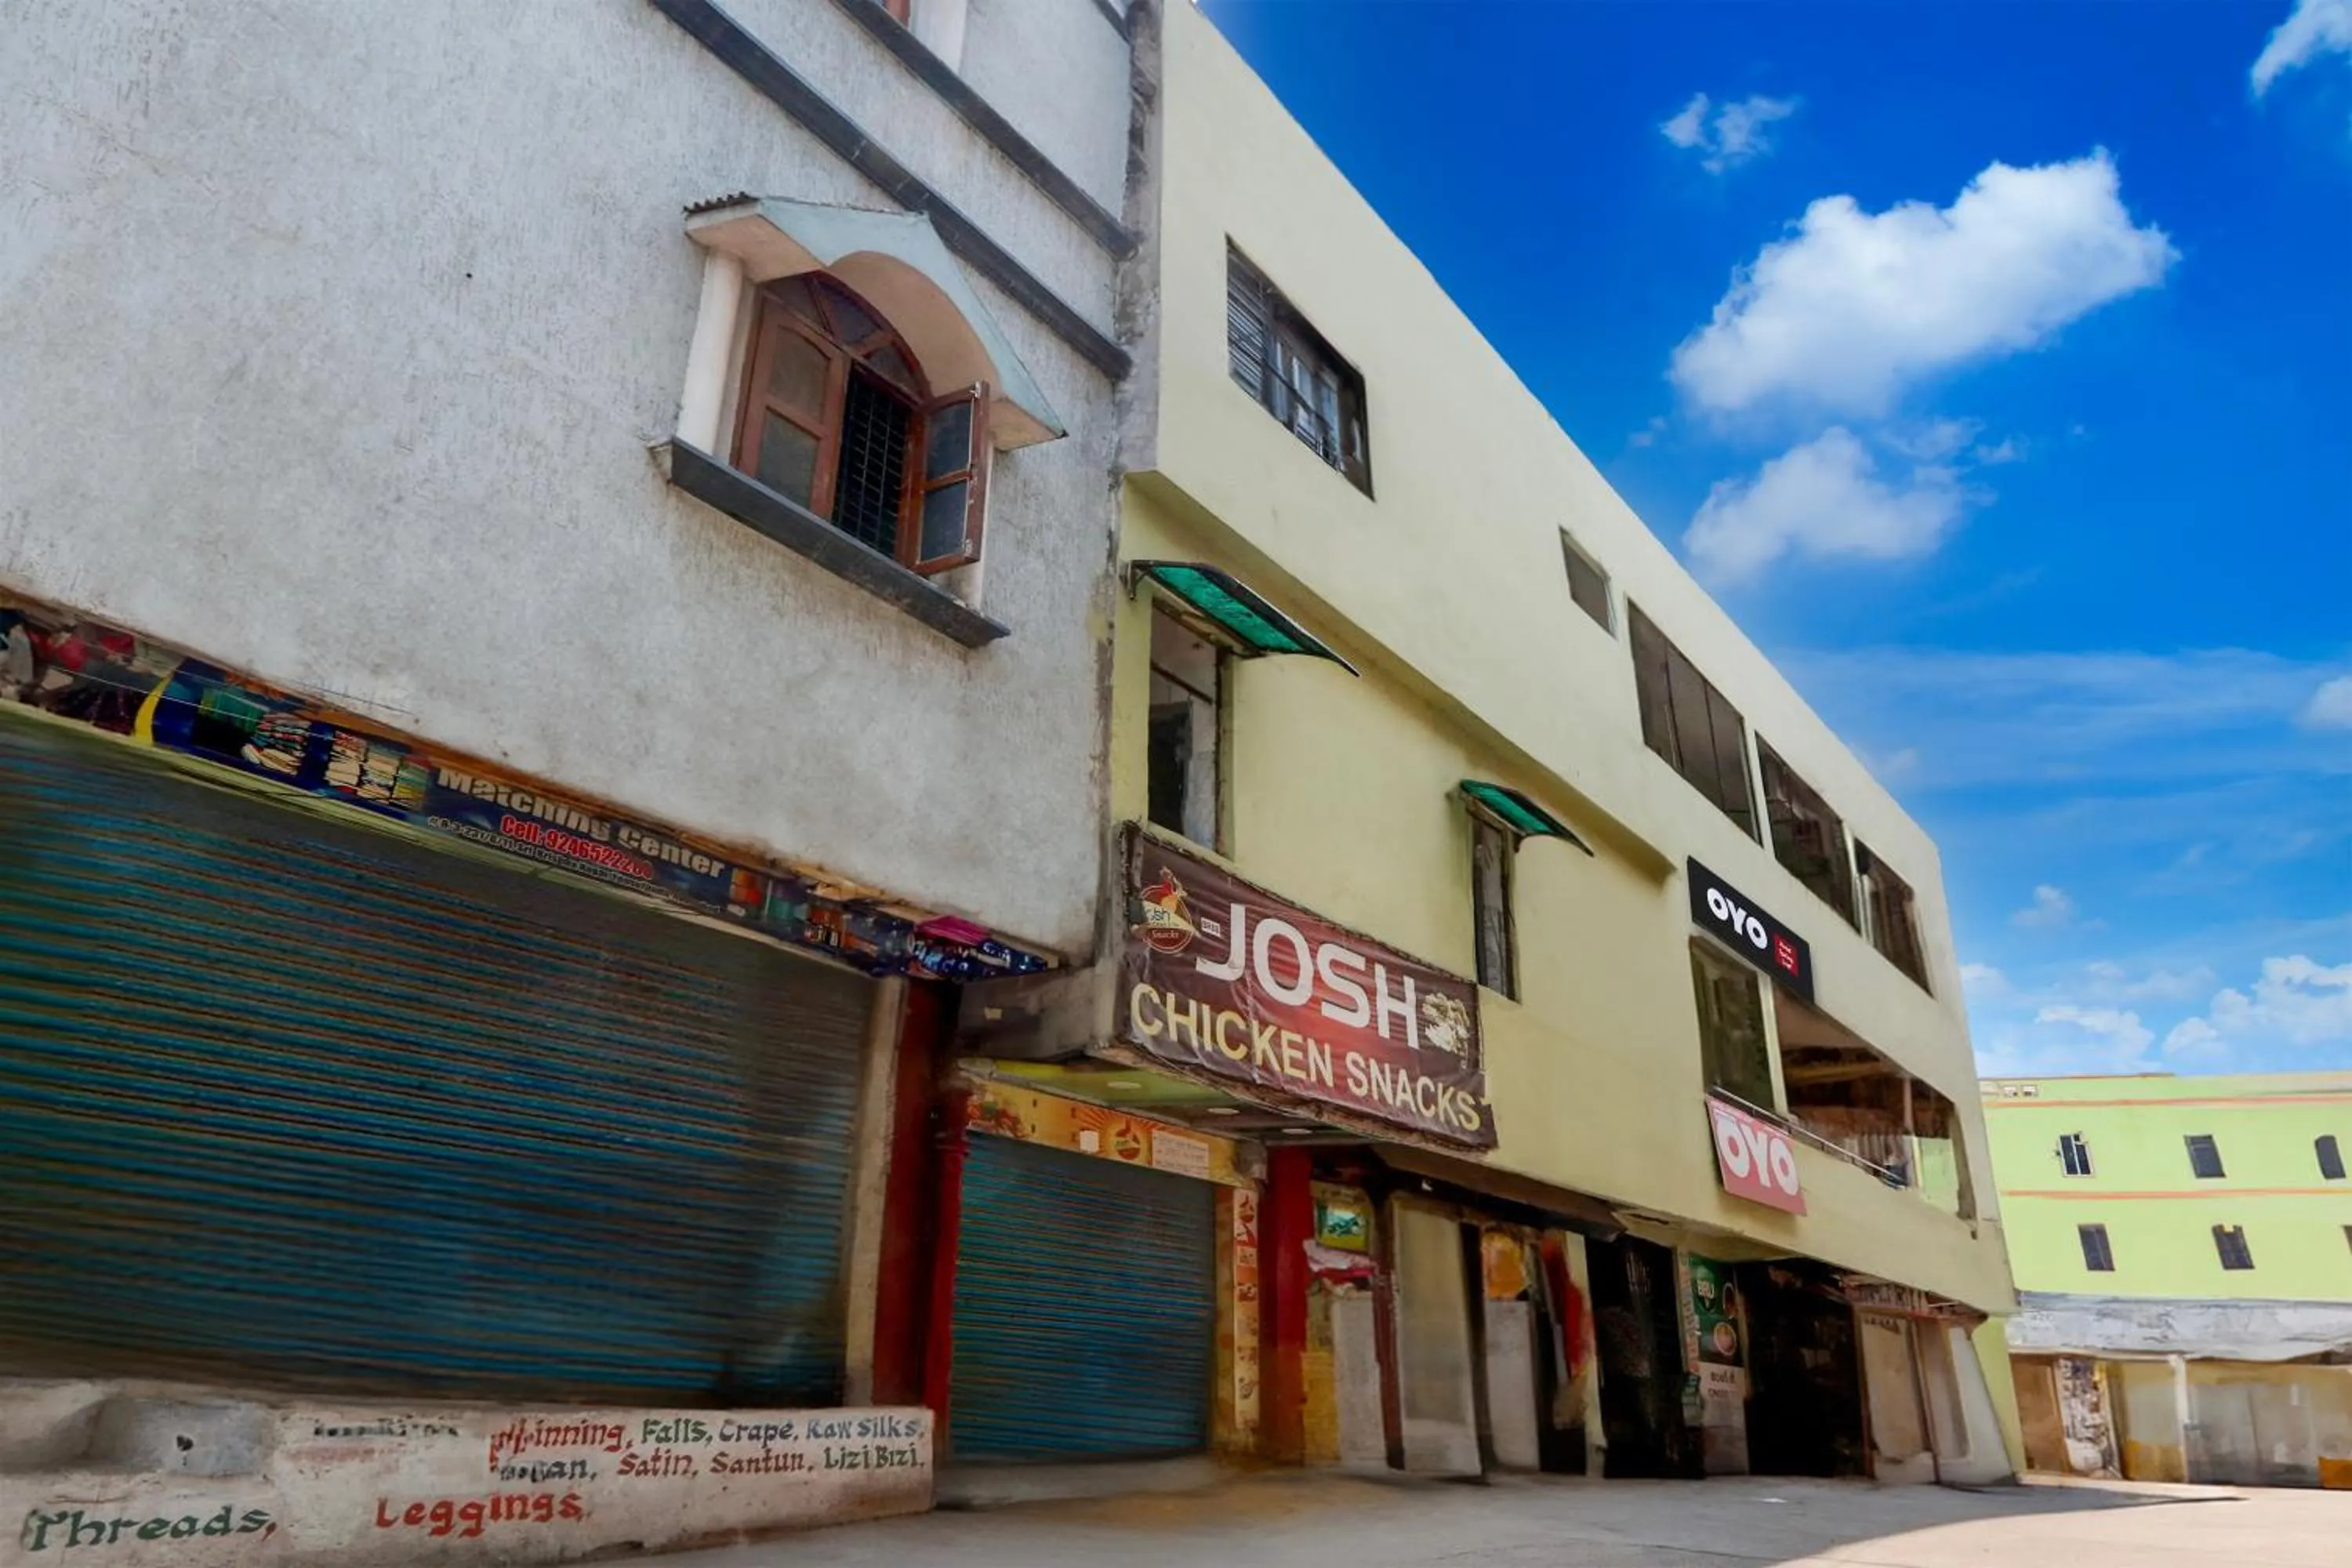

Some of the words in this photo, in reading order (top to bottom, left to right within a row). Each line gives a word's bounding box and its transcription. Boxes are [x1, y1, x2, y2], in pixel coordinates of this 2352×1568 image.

[500, 813, 543, 845] Cell:
[618, 826, 726, 878] Center
[1706, 887, 1768, 949] OYO
[1196, 902, 1421, 1051] JOSH
[1131, 982, 1334, 1088] CHICKEN
[1345, 1051, 1482, 1132] SNACKS
[1716, 1113, 1799, 1196] OYO
[641, 1417, 713, 1449] Falls,
[806, 1419, 851, 1439] Raw
